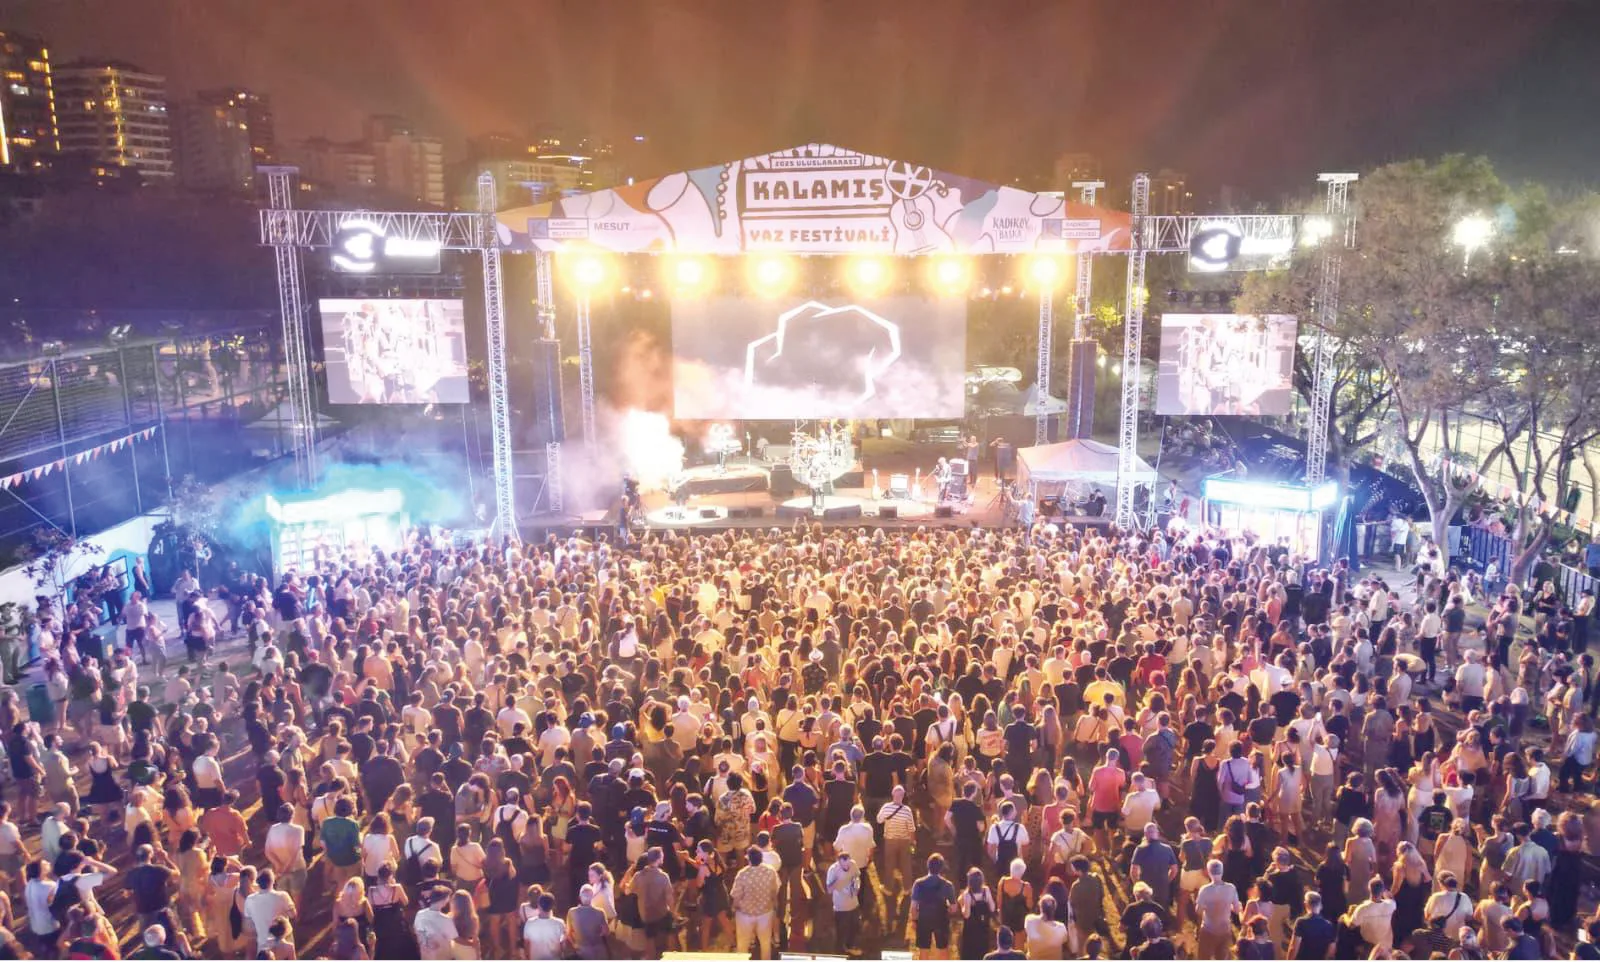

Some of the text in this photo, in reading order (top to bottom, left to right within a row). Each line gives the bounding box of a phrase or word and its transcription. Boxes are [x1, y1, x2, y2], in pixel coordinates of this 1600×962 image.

[796, 159, 858, 167] ULUSLARARASI
[753, 179, 883, 200] KALAMIŞ
[594, 222, 630, 231] MESUT
[749, 226, 890, 242] YAZ FESTİVALİ
